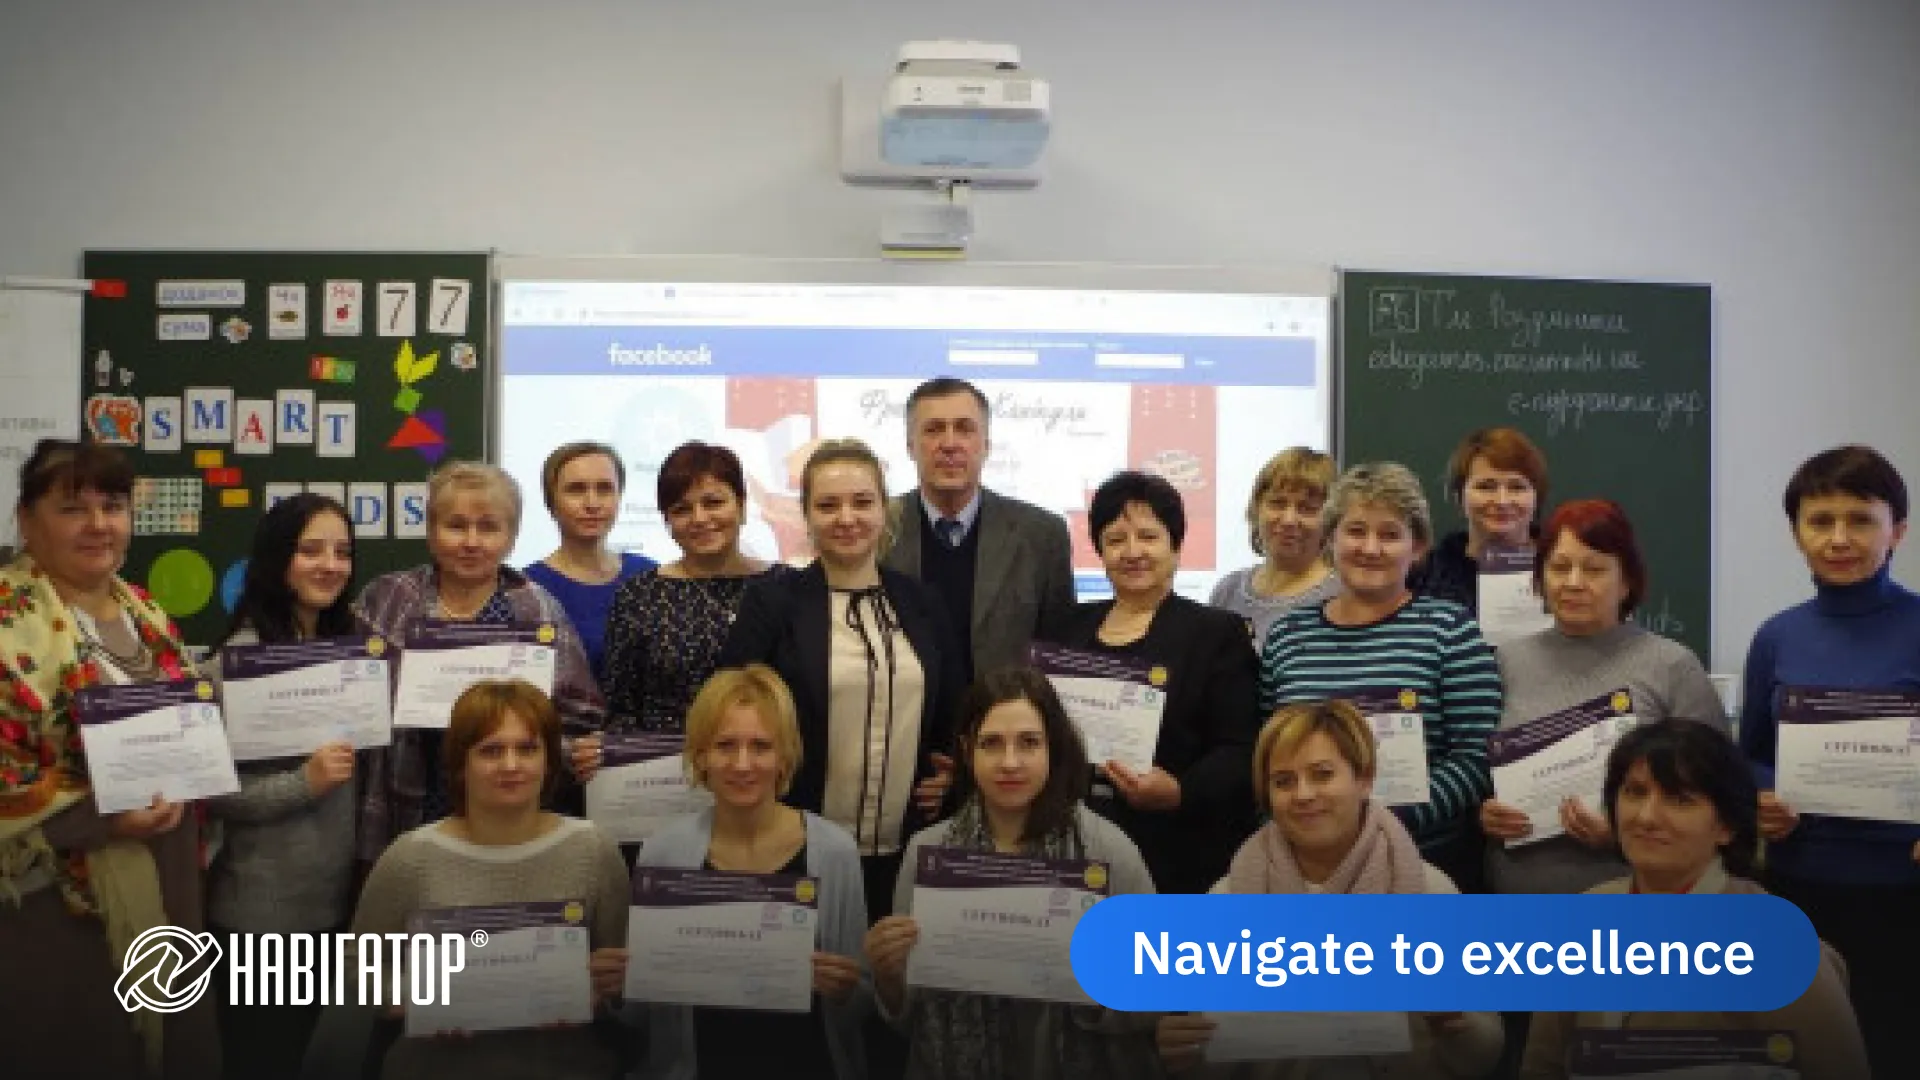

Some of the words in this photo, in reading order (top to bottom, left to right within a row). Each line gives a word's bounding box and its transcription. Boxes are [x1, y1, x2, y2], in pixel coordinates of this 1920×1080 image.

[384, 289, 409, 332] 7
[439, 285, 463, 327] 7
[608, 342, 712, 366] facebook
[151, 400, 349, 443] SMART
